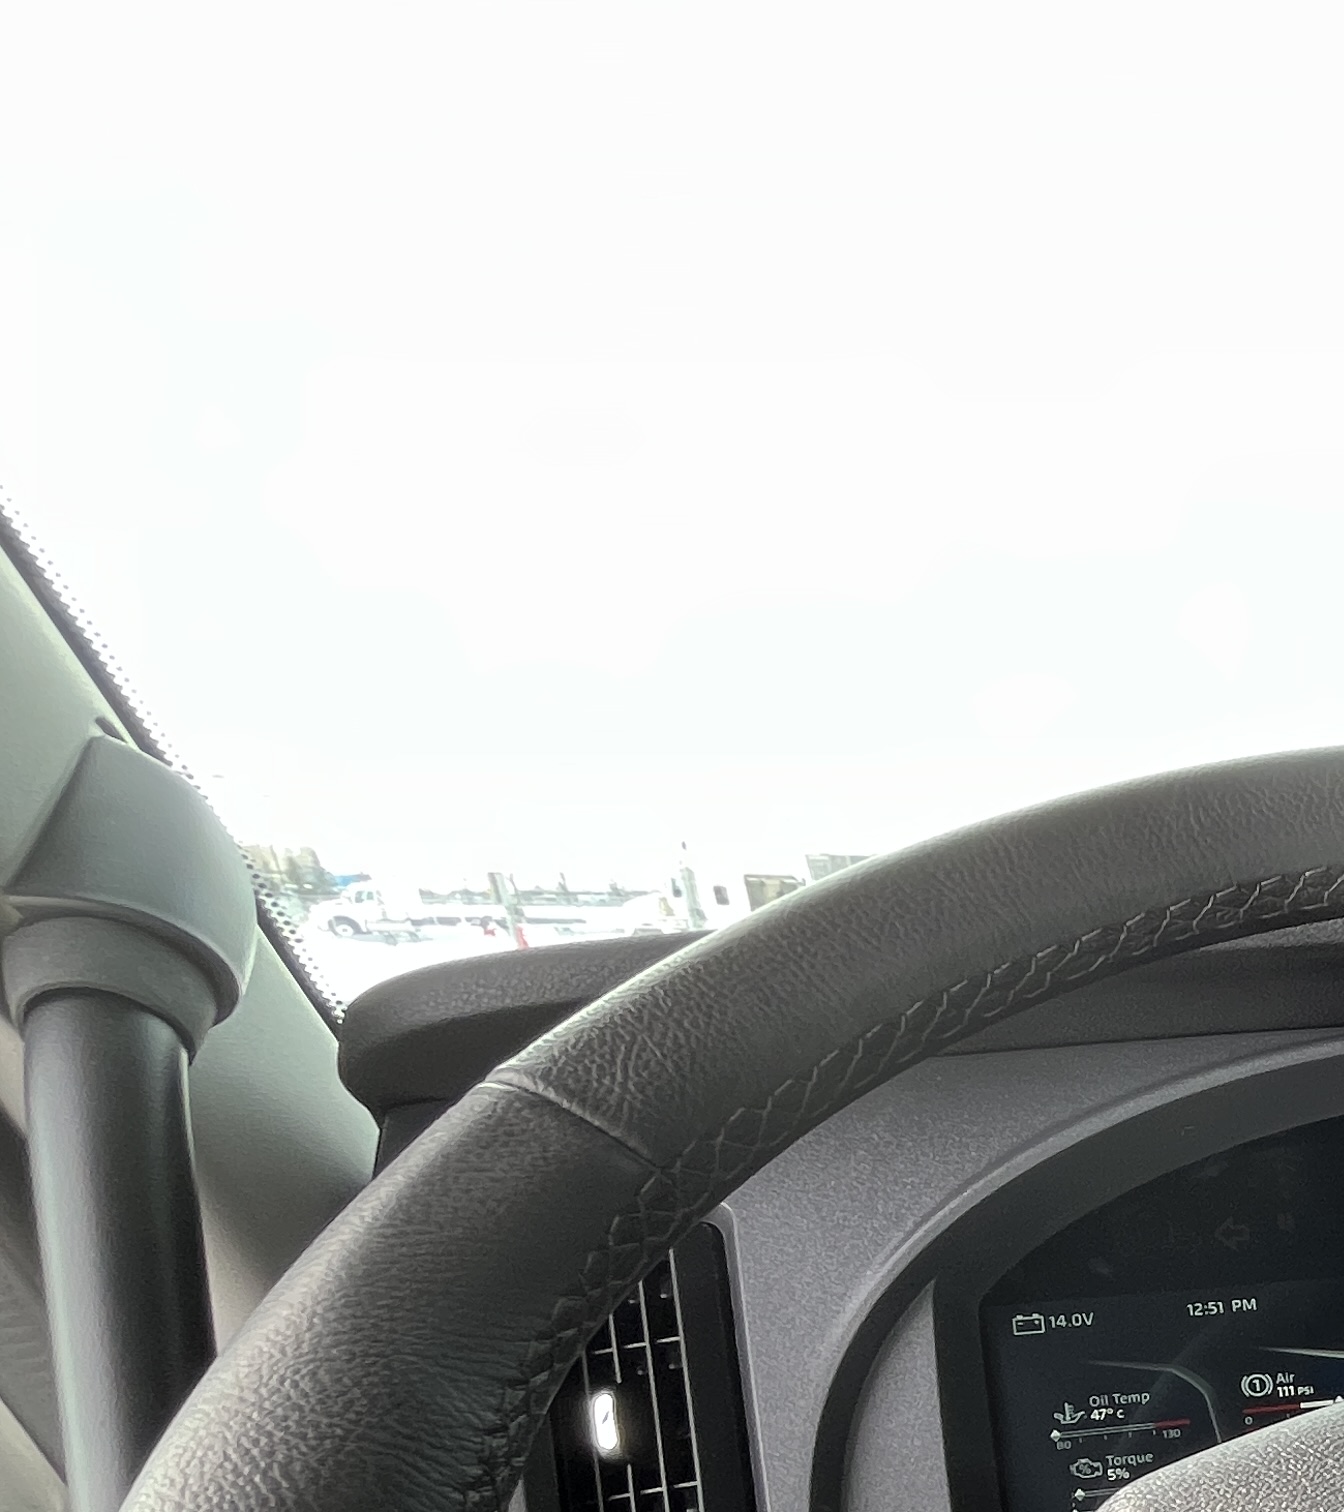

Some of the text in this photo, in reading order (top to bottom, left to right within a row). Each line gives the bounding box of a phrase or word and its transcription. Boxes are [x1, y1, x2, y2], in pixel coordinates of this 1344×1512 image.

[1187, 1298, 1257, 1316] 12:51 PM
[1049, 1312, 1094, 1328] 14.0V
[1276, 1371, 1295, 1385] Air
[1277, 1384, 1295, 1397] 111
[1089, 1391, 1150, 1408] Oil Temp
[1162, 1428, 1181, 1440] 130
[1106, 1452, 1154, 1469] Torque
[1107, 1466, 1130, 1481] 5%
